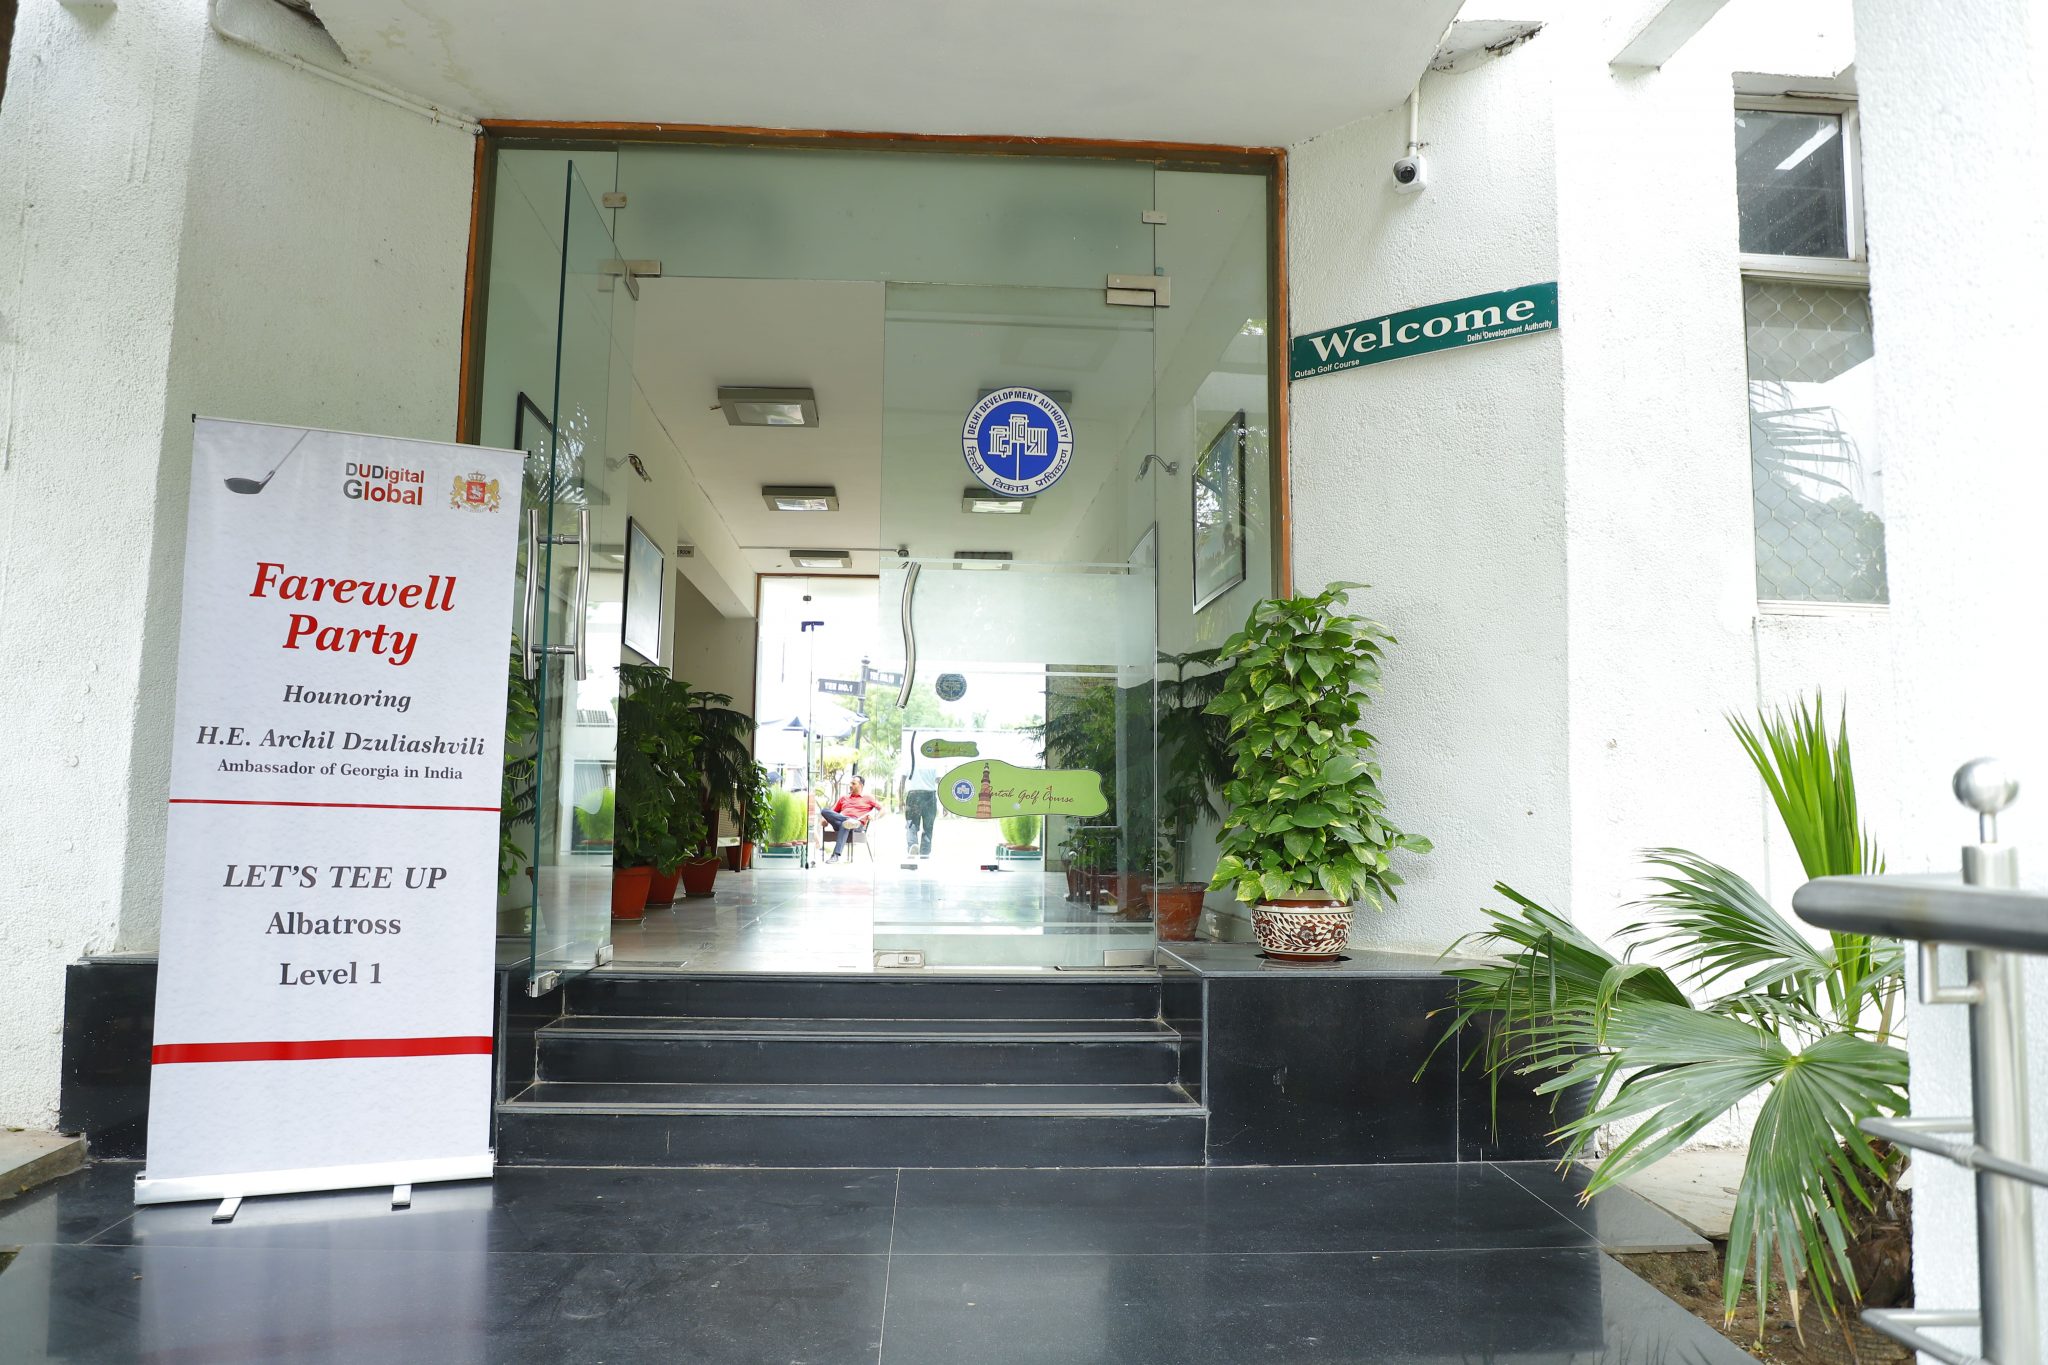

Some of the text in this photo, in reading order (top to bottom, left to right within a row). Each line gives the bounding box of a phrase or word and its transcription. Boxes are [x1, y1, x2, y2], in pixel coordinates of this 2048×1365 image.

[1309, 299, 1536, 362] Welcome
[1467, 319, 1552, 342] Delhi Development Authority
[1294, 359, 1360, 378] Qutab Golf Course
[967, 391, 1069, 438] DELHI DEVELOPMENT AUTHORITY
[345, 462, 425, 484] DUDigital
[342, 479, 423, 506] Global
[249, 561, 457, 611] Farewell
[282, 613, 419, 666] Party
[282, 684, 412, 713] Hounoring
[196, 725, 485, 756] H.E. Archil Dzuliashvili
[217, 758, 463, 780] Ambassador of Georgia in India
[1018, 789, 1040, 805] Golf
[222, 863, 448, 889] LET'S TEE UP
[265, 911, 401, 935] Albatross
[279, 961, 382, 986] Level 1
